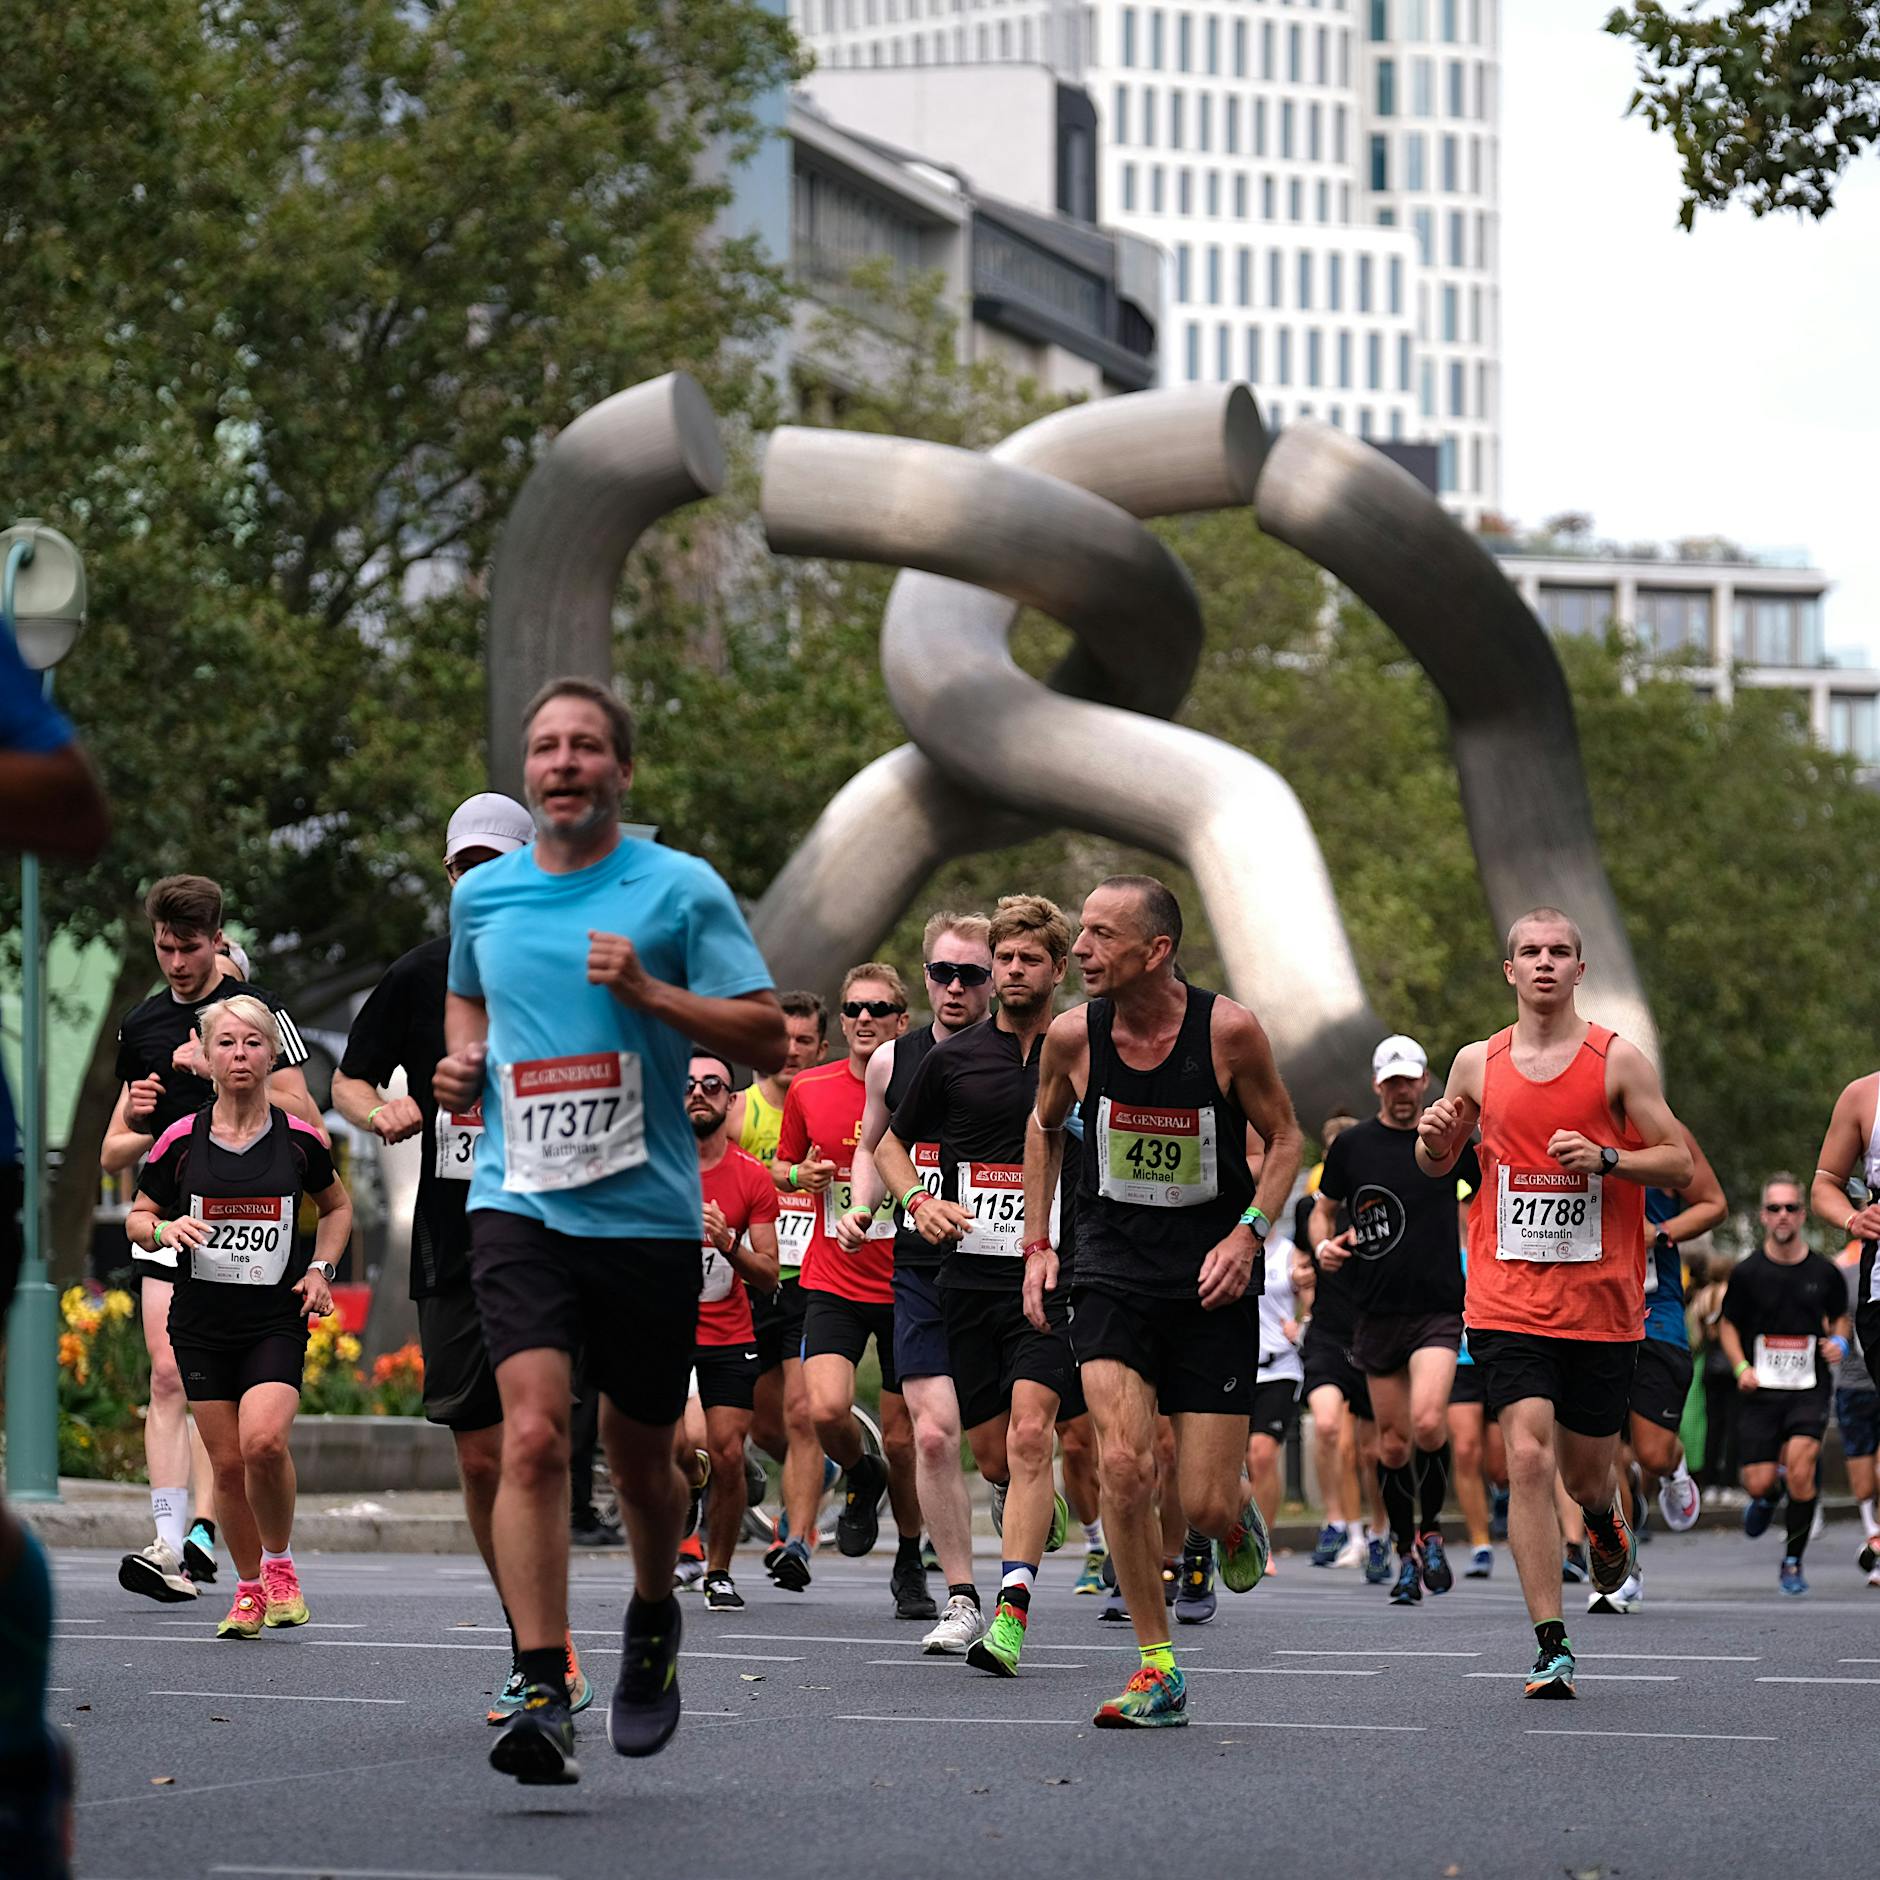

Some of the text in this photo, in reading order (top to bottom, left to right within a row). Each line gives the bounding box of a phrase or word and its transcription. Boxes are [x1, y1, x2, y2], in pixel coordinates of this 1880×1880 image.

[538, 1063, 611, 1084] GENERALI
[522, 1097, 620, 1142] 17377
[1132, 1114, 1190, 1129] GENERALI
[1203, 1138, 1210, 1146] A
[1125, 1138, 1182, 1170] 439
[1132, 1169, 1174, 1182] Michael
[1529, 1174, 1580, 1185] GENERALI
[1591, 1195, 1597, 1203] B
[224, 1204, 275, 1215] GENERALI
[1511, 1197, 1586, 1226] 21788
[993, 1223, 1016, 1233] Felix
[1521, 1228, 1573, 1239] Constantin
[207, 1225, 279, 1252] 22590
[231, 1253, 250, 1263] Ines
